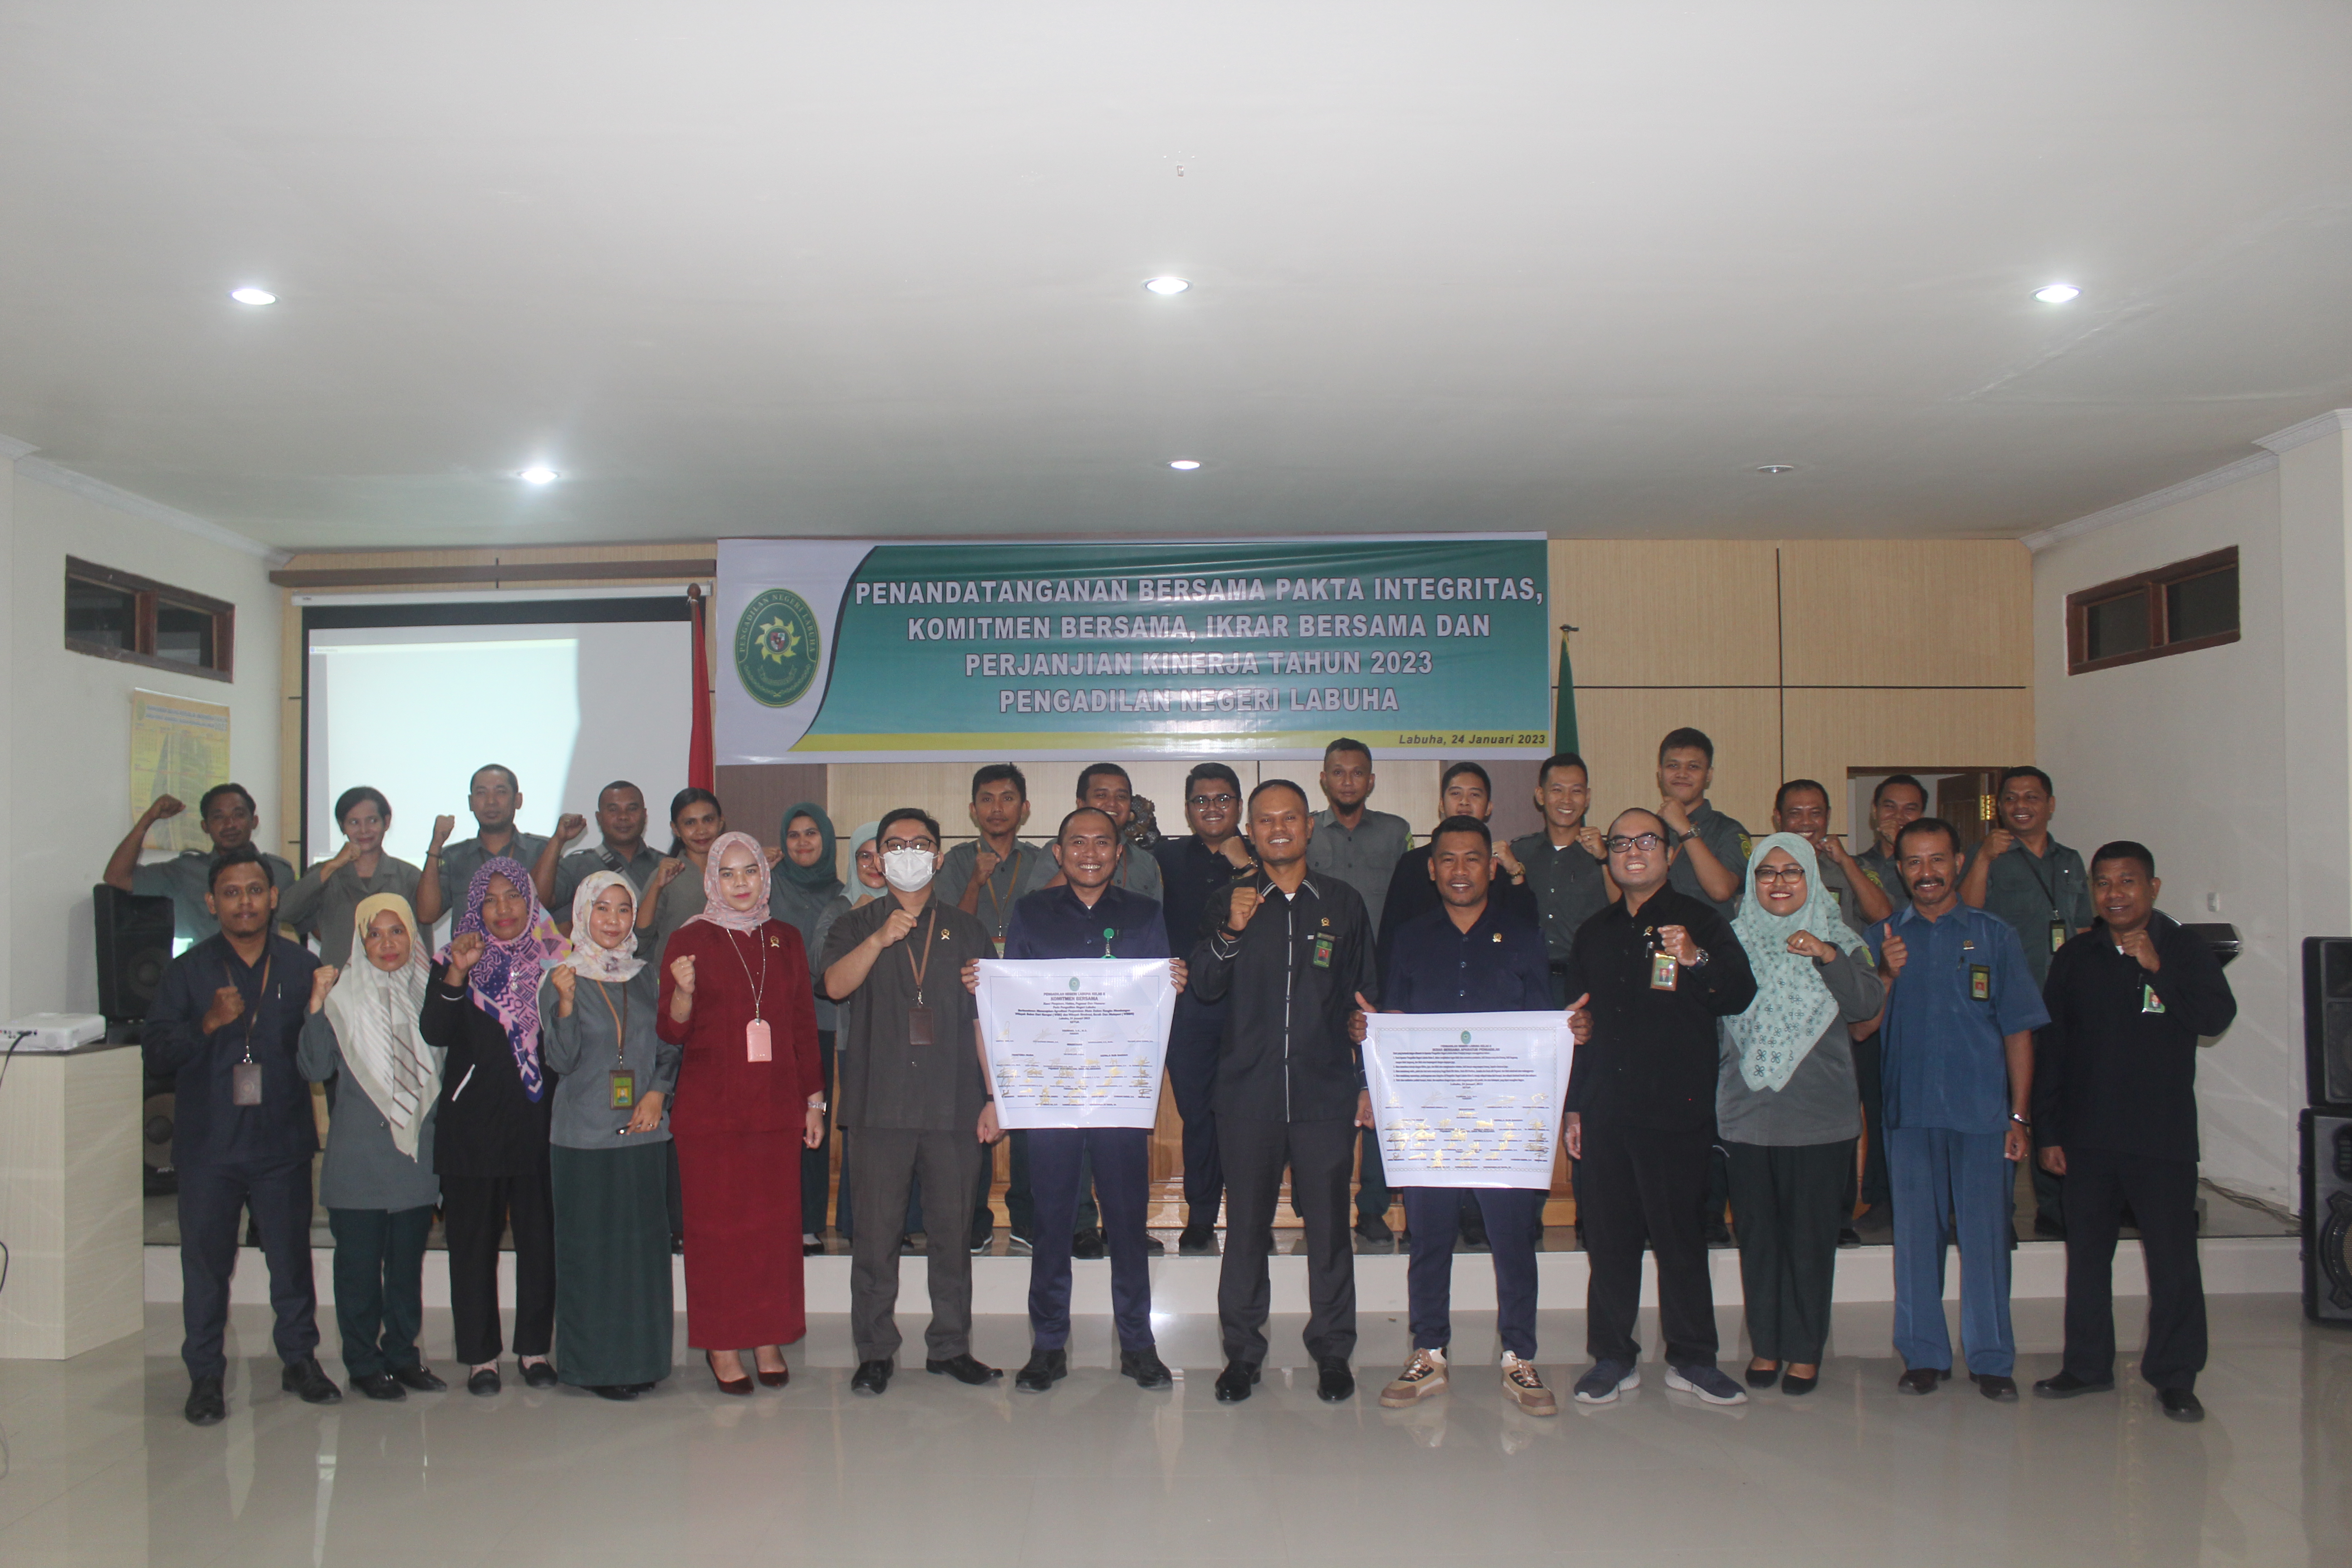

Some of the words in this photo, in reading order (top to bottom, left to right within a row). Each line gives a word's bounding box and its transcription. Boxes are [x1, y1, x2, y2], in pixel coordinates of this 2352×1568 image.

[855, 579, 1128, 604] PENANDATANGANAN
[1138, 578, 1266, 602] BERSAMA
[1275, 578, 1364, 601] PAKTA
[1374, 577, 1543, 605] INTEGRITAS,
[739, 598, 769, 652] PENGADILAN
[772, 593, 804, 612] NEGERI
[802, 613, 816, 652] LABUHA
[908, 617, 1051, 640] KOMITMEN
[1061, 615, 1196, 643] BERSAMA,
[1206, 615, 1289, 637] IKRAR
[1298, 614, 1427, 637] BERSAMA
[1436, 614, 1490, 637] DAN
[965, 652, 1132, 676] PERJANJIAN
[1142, 652, 1259, 675] KINERJA
[1268, 651, 1360, 674] TAHUN
[1370, 651, 1433, 674] 2023
[1000, 689, 1171, 713] PENGADILAN
[1181, 688, 1279, 712] NEGERI
[1290, 688, 1399, 711] LABUHA
[1399, 735, 1447, 745] Labuha,
[1451, 735, 1465, 744] 24
[1468, 734, 1514, 744] Januari
[1518, 734, 1545, 744] 2023
